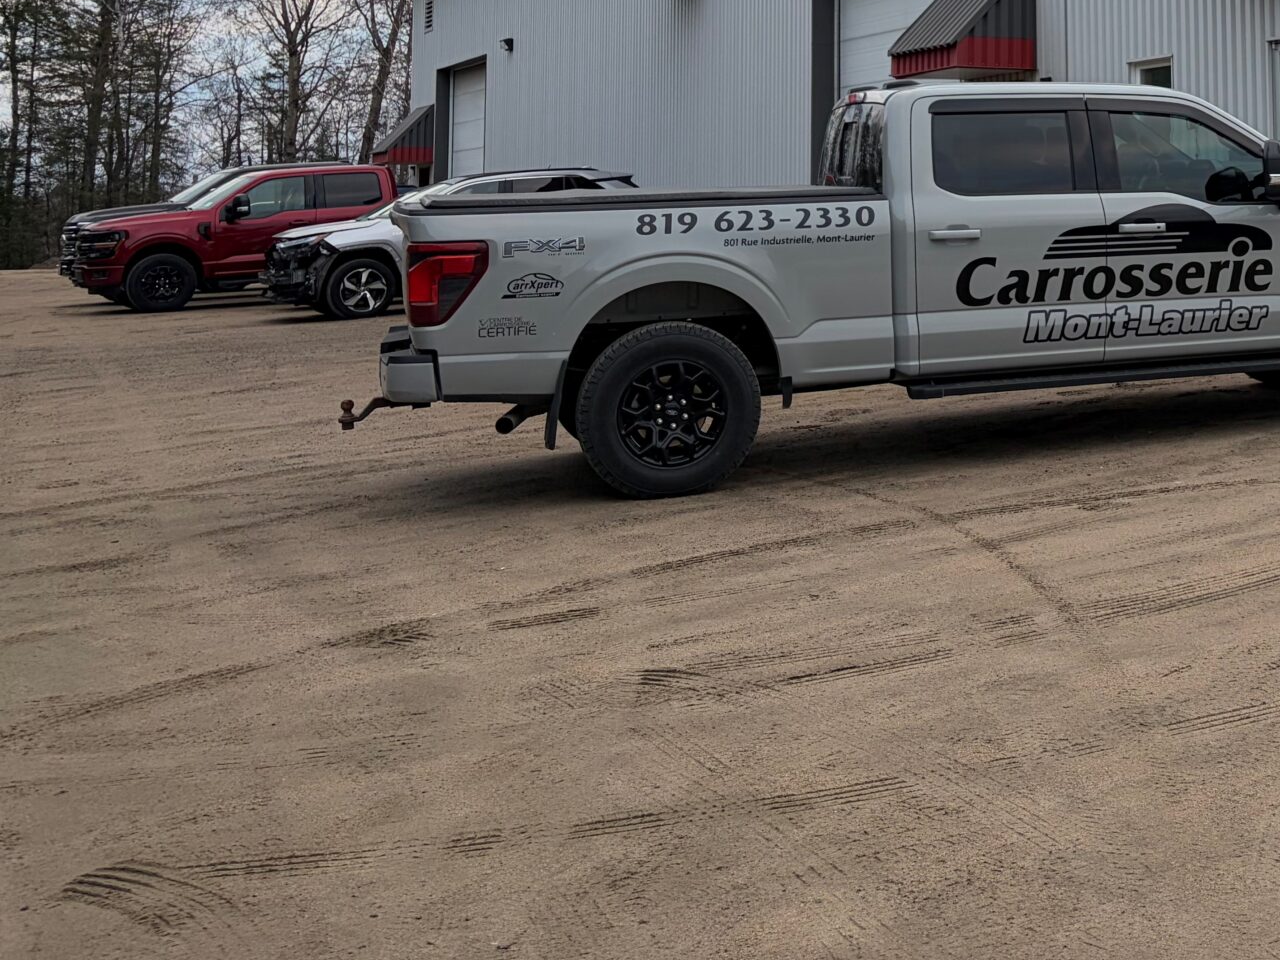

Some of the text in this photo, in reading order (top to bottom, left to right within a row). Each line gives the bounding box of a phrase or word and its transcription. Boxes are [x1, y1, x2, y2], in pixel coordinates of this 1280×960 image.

[636, 205, 875, 235] 819 623-2330
[502, 236, 586, 258] FX4
[723, 232, 875, 247] 801 Rue Industrielle, Mont-Laurier
[956, 237, 1273, 306] Carrosserie
[1023, 299, 1270, 343] Mont-Laurier
